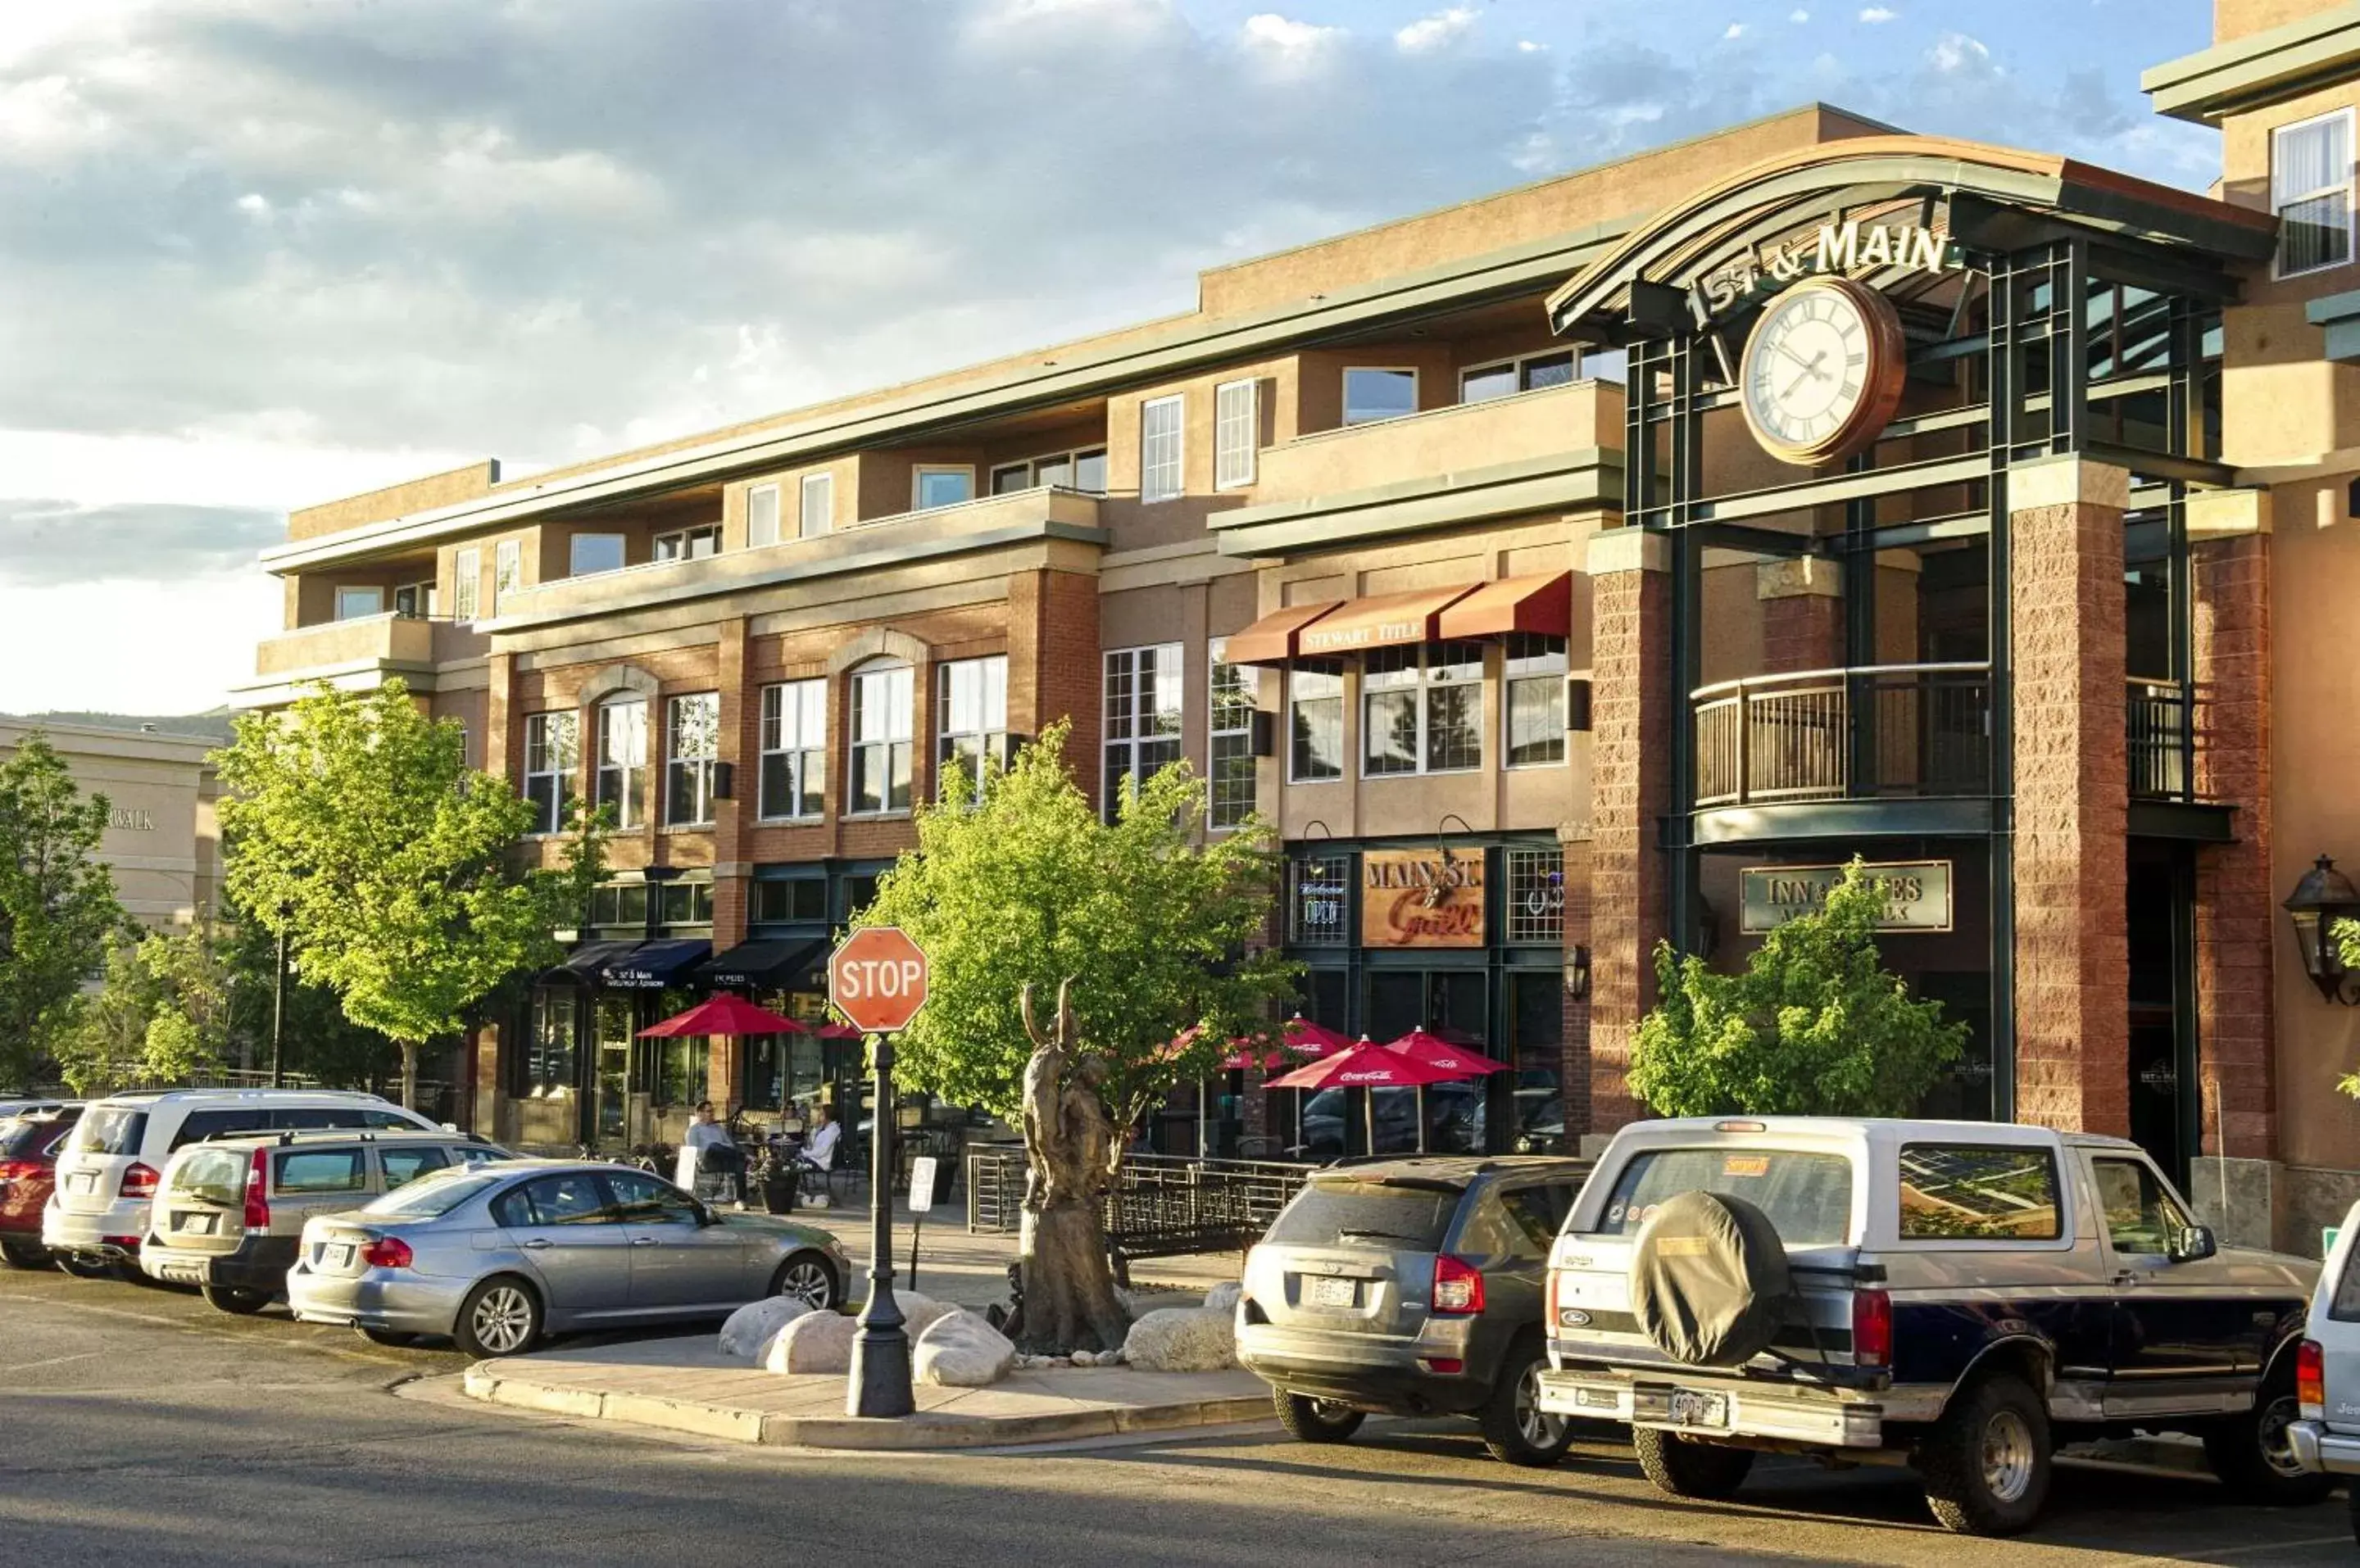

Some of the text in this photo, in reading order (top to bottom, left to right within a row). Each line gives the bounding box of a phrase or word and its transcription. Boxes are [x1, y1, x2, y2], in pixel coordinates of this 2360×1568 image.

[1772, 241, 1808, 282] &
[1814, 220, 1948, 275] MAIN
[1305, 623, 1421, 648] STEWART TITLE
[1368, 861, 1432, 889] MAIN
[1766, 877, 1812, 905] INN
[1815, 882, 1827, 903] &
[1305, 900, 1337, 924] OPEN
[1387, 887, 1482, 945] Grill
[841, 960, 921, 998] STOP
[1340, 1070, 1393, 1082] Coca-Cola
